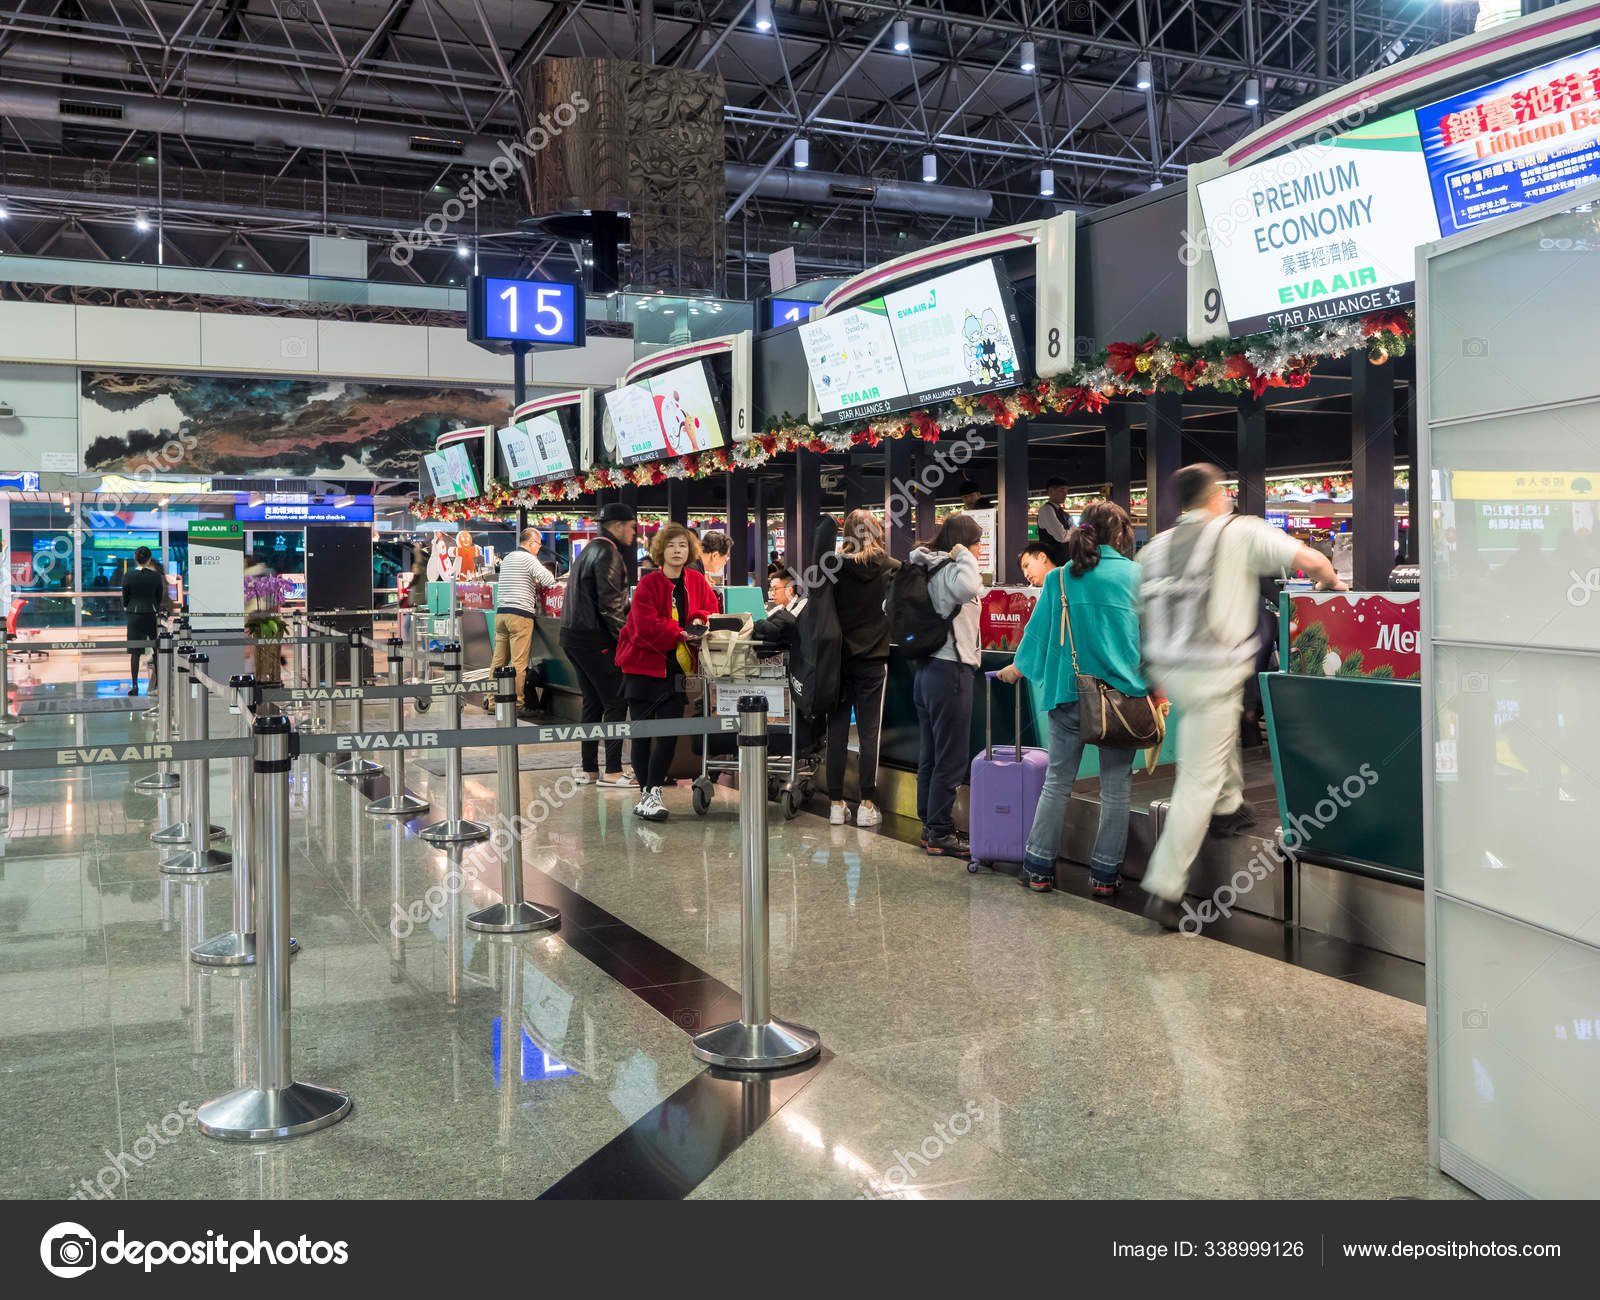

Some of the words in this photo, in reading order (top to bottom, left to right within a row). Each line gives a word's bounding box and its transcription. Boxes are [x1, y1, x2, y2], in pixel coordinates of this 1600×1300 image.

[1475, 119, 1567, 159] Lithium
[1252, 160, 1360, 218] PREMIUM
[1253, 194, 1373, 253] ECONOMY
[1281, 238, 1359, 277] 豪華經濟艙
[500, 286, 564, 336] 15
[1203, 287, 1221, 324] 9
[1267, 309, 1304, 330] STAR
[1307, 292, 1383, 323] ALLIANCE
[1047, 327, 1061, 359] 8
[838, 409, 856, 421] STAR
[856, 402, 885, 417] ALLIANCE
[919, 393, 932, 403] STAR
[931, 388, 957, 401] ALLIANCE
[738, 408, 745, 430] 6
